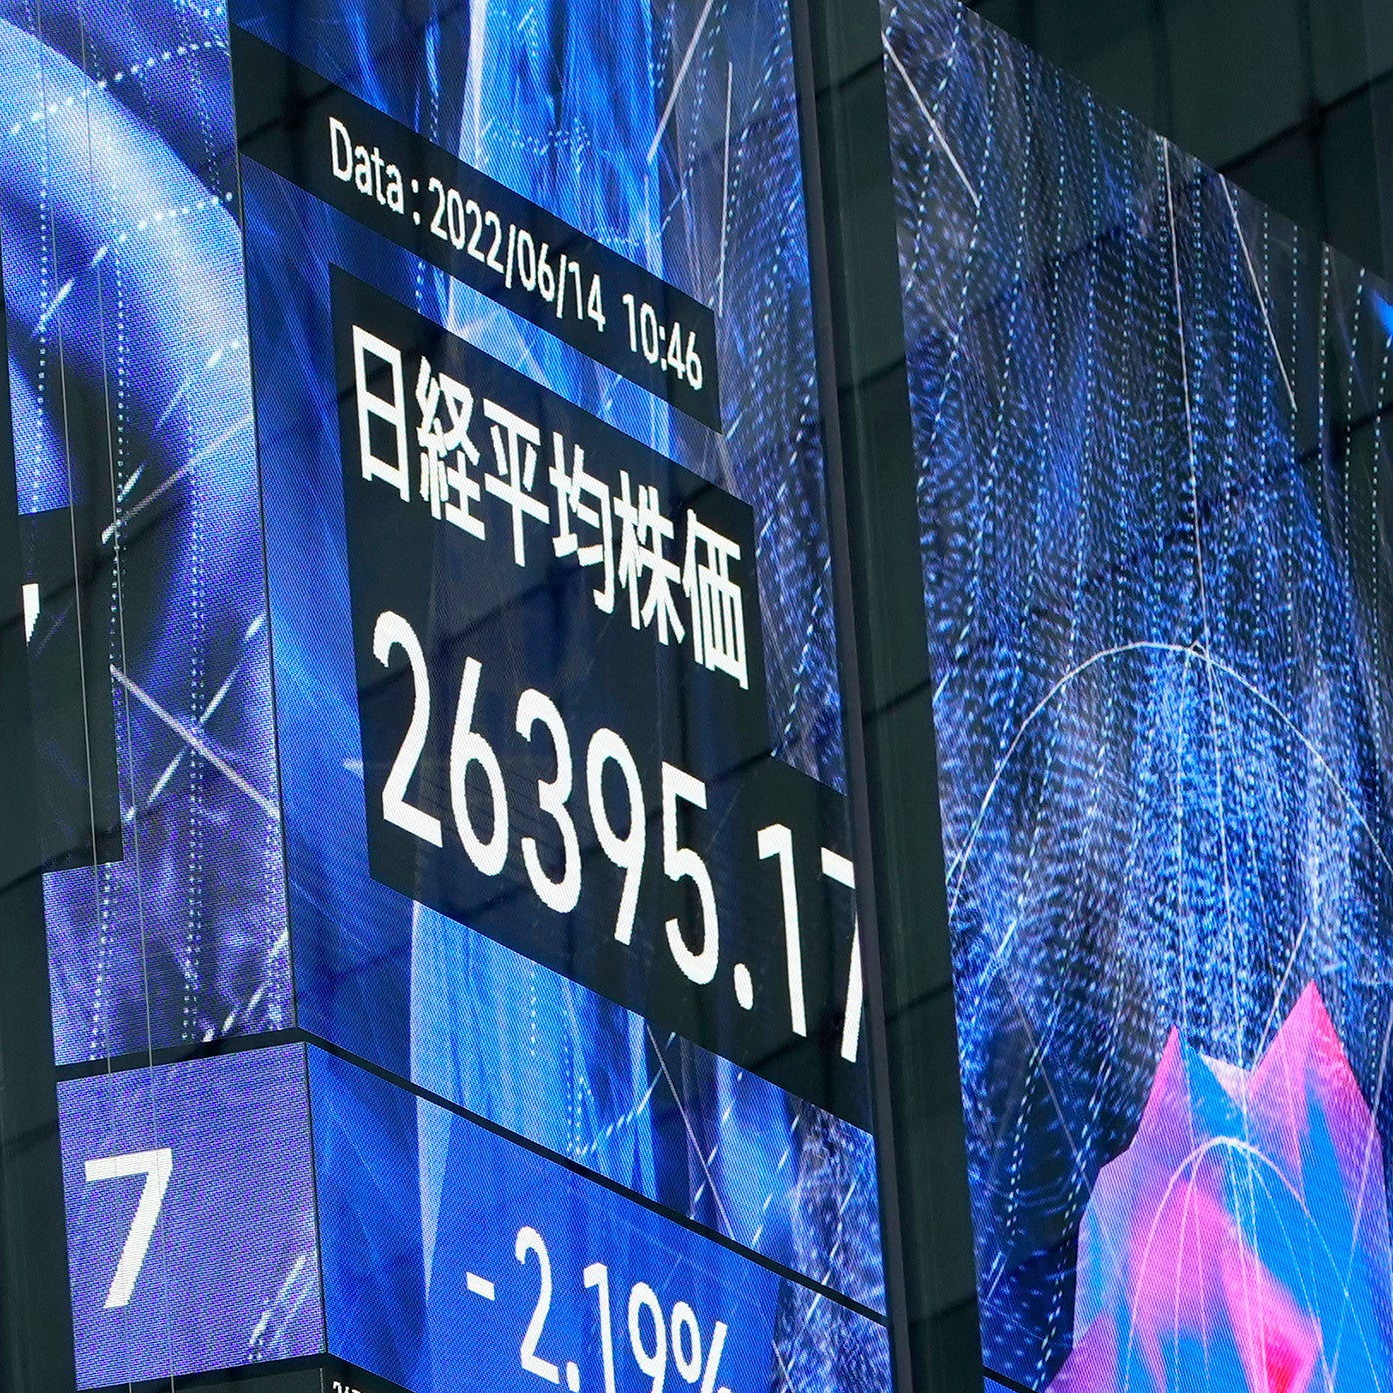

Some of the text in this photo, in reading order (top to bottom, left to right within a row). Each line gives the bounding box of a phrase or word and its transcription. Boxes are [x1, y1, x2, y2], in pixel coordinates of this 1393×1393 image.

[429, 178, 605, 332] 2022/06/14
[623, 294, 702, 389] 10:46
[353, 324, 748, 690] 日経平均株価
[373, 610, 863, 1062] 26395.17
